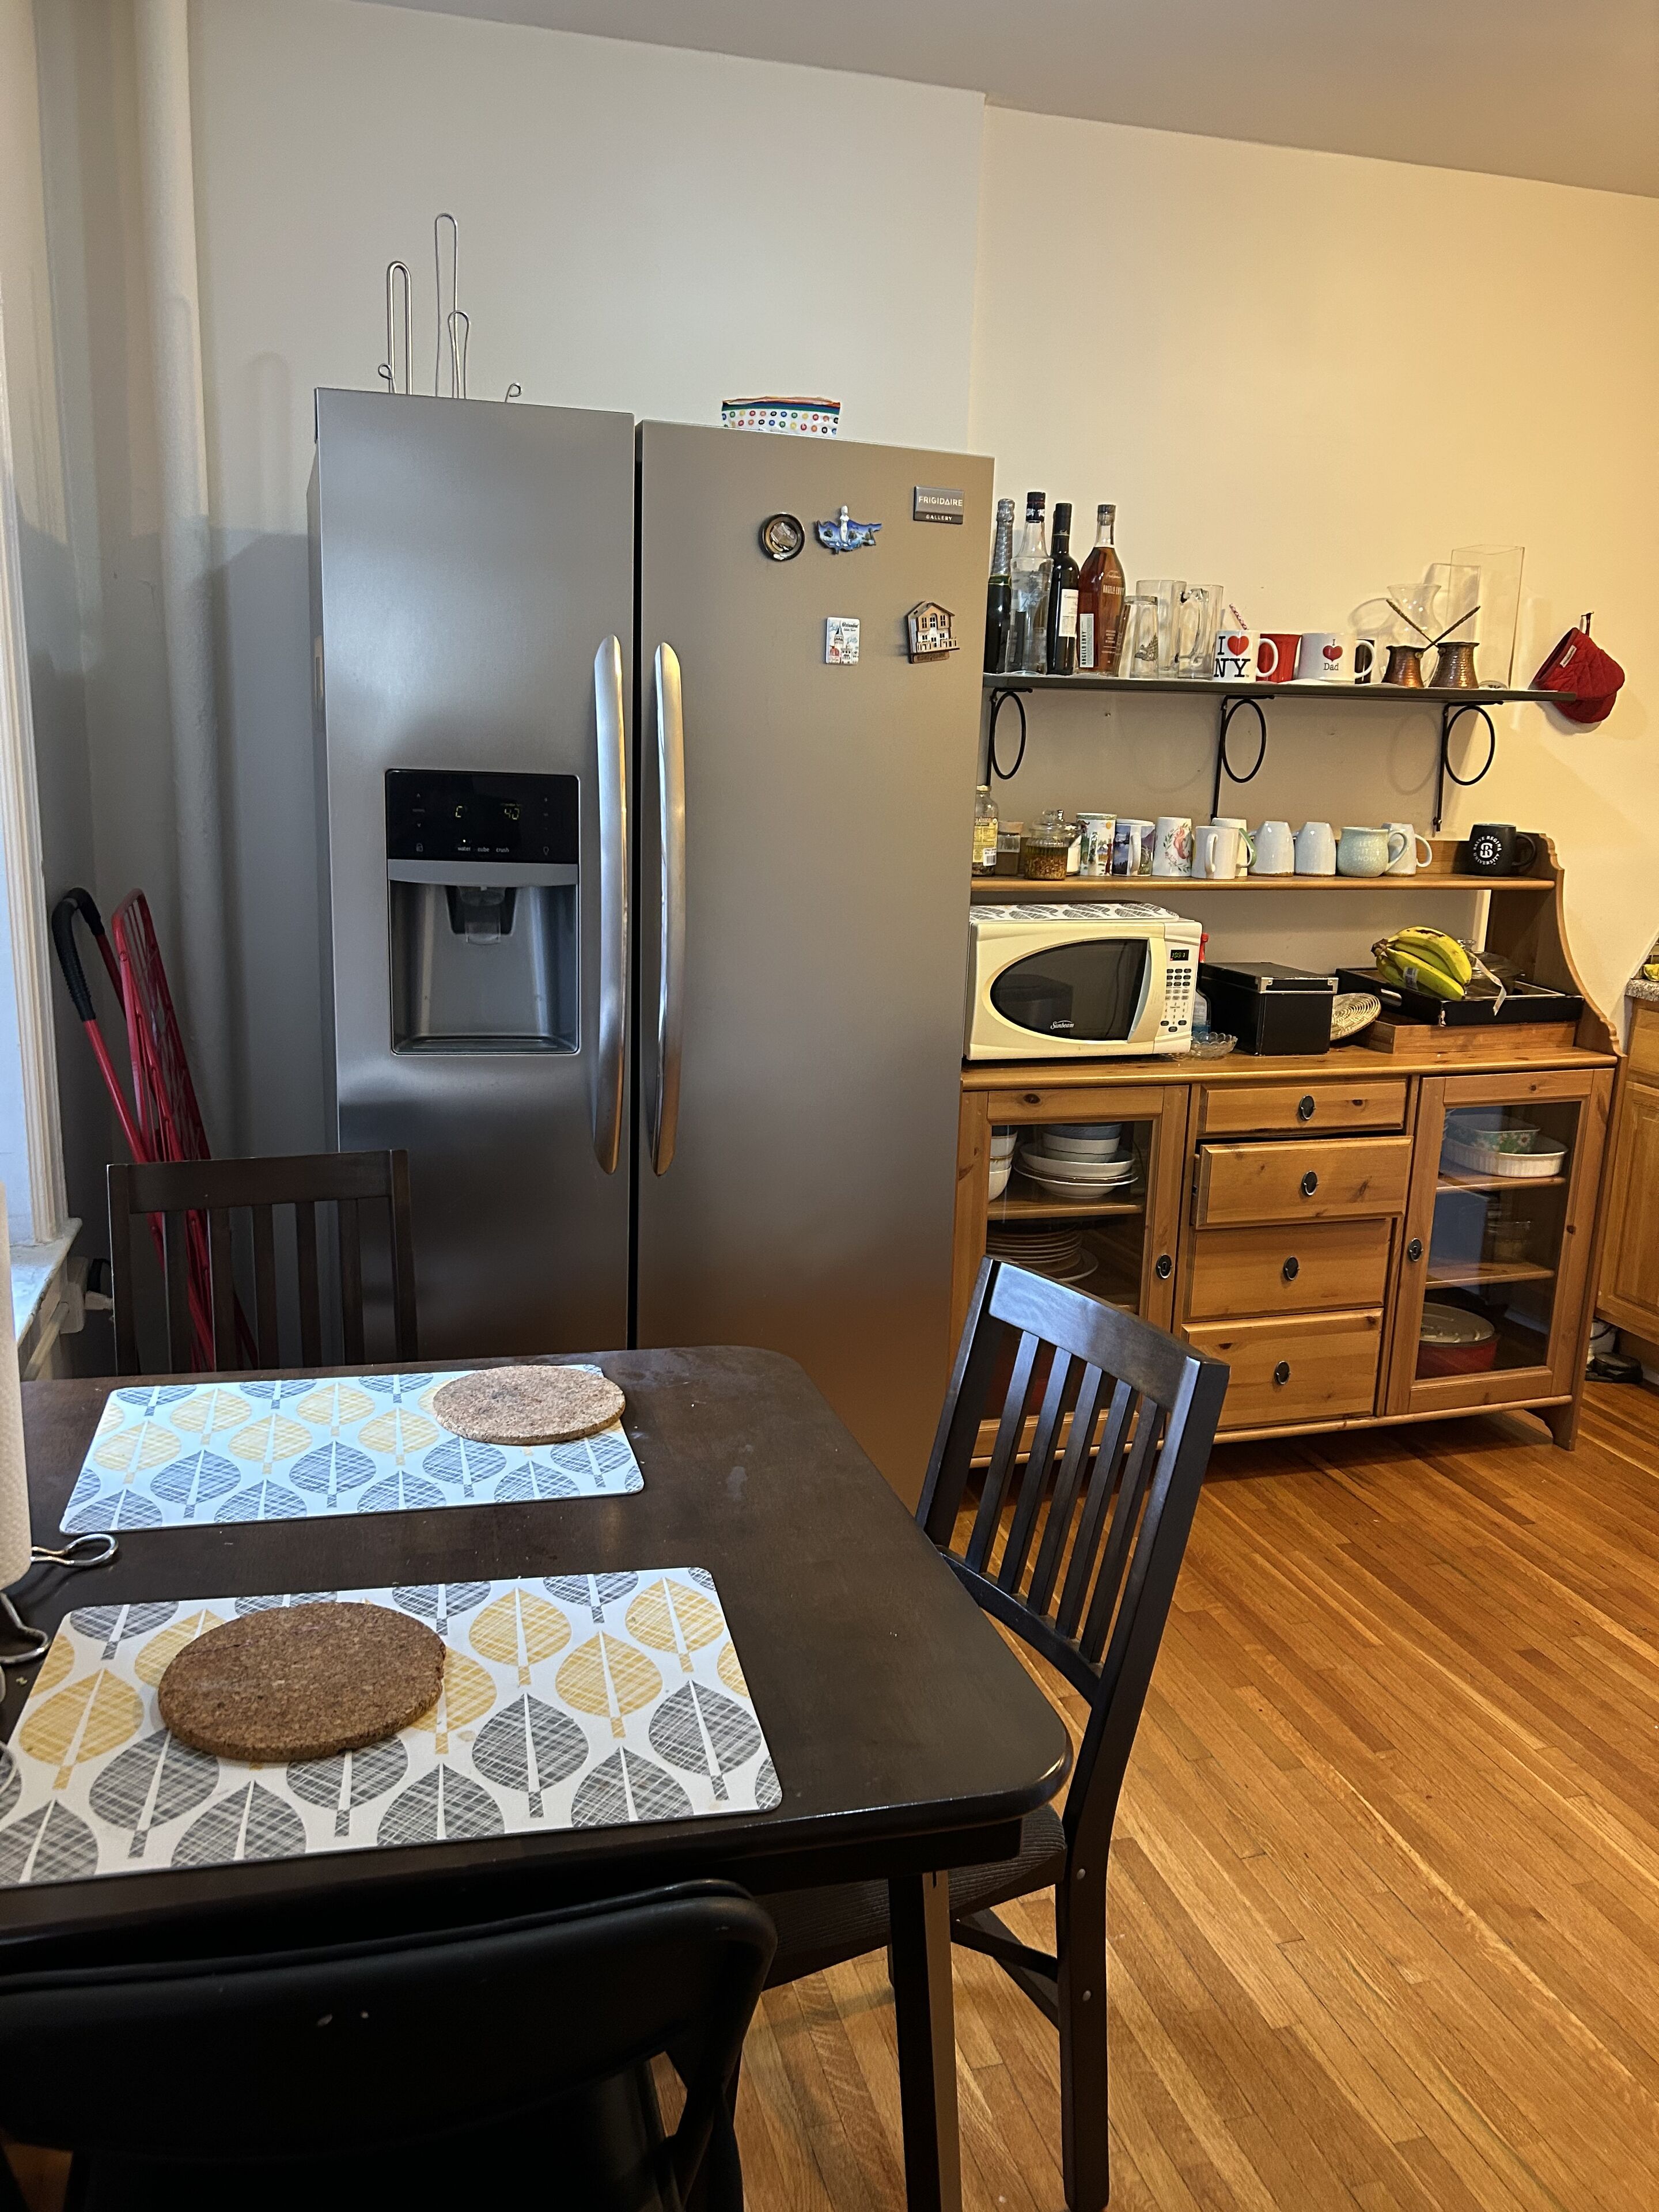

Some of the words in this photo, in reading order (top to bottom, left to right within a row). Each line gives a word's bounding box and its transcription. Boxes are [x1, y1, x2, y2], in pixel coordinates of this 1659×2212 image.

[918, 496, 963, 506] FRIGIDAIRE
[1217, 635, 1226, 655] I
[1213, 658, 1251, 677] NY
[1323, 662, 1339, 671] Dad
[1473, 836, 1486, 850] SALVE
[1486, 835, 1502, 851] REGINA
[1473, 853, 1500, 865] UNIVERSITY
[1050, 1021, 1074, 1029] Sunbeam
